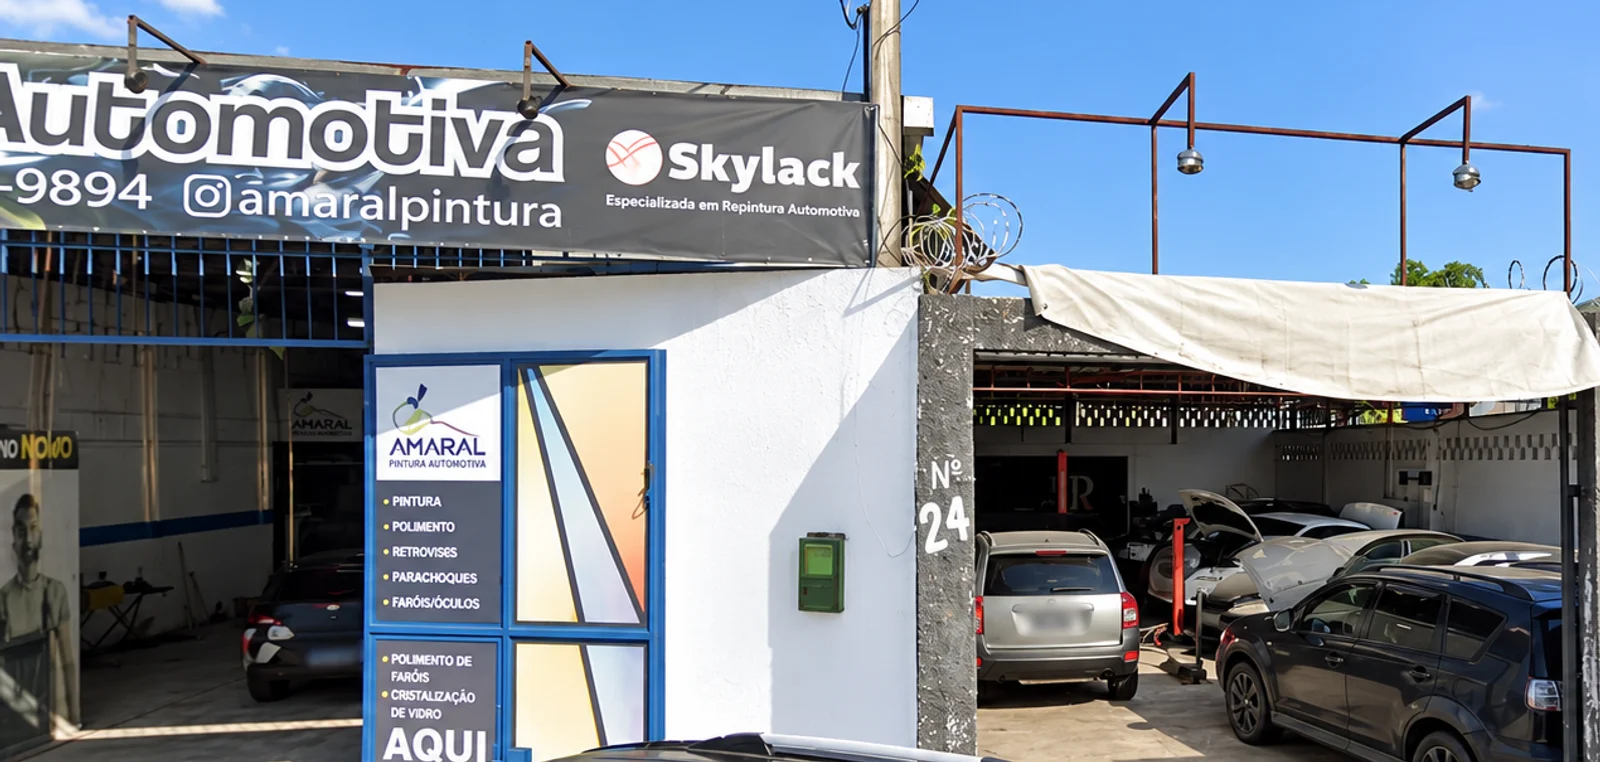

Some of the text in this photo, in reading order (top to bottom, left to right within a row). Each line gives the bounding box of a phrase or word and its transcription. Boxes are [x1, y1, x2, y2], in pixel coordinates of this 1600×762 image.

[668, 142, 861, 193] Skylack
[239, 183, 563, 229] amaralpintura
[606, 194, 860, 218] Especializada em Repintura Automotiva
[292, 419, 352, 430] AMARAL
[389, 437, 487, 456] AMARAL
[389, 459, 487, 468] PINTURA AUTOMOTIVA
[392, 495, 442, 507] PINTURA
[392, 521, 456, 533] POLIMENTO
[919, 495, 970, 554] 24
[392, 571, 478, 585] PARACHOQUES
[392, 595, 480, 610] FARÓIS/ÓCULOS
[391, 653, 473, 667] POLIMENTO DE
[391, 668, 430, 683] FARÓIS
[391, 688, 476, 705] CRISTALIZAÇÃO
[391, 707, 442, 720] DE VIDRO
[382, 726, 487, 762] AQUI
